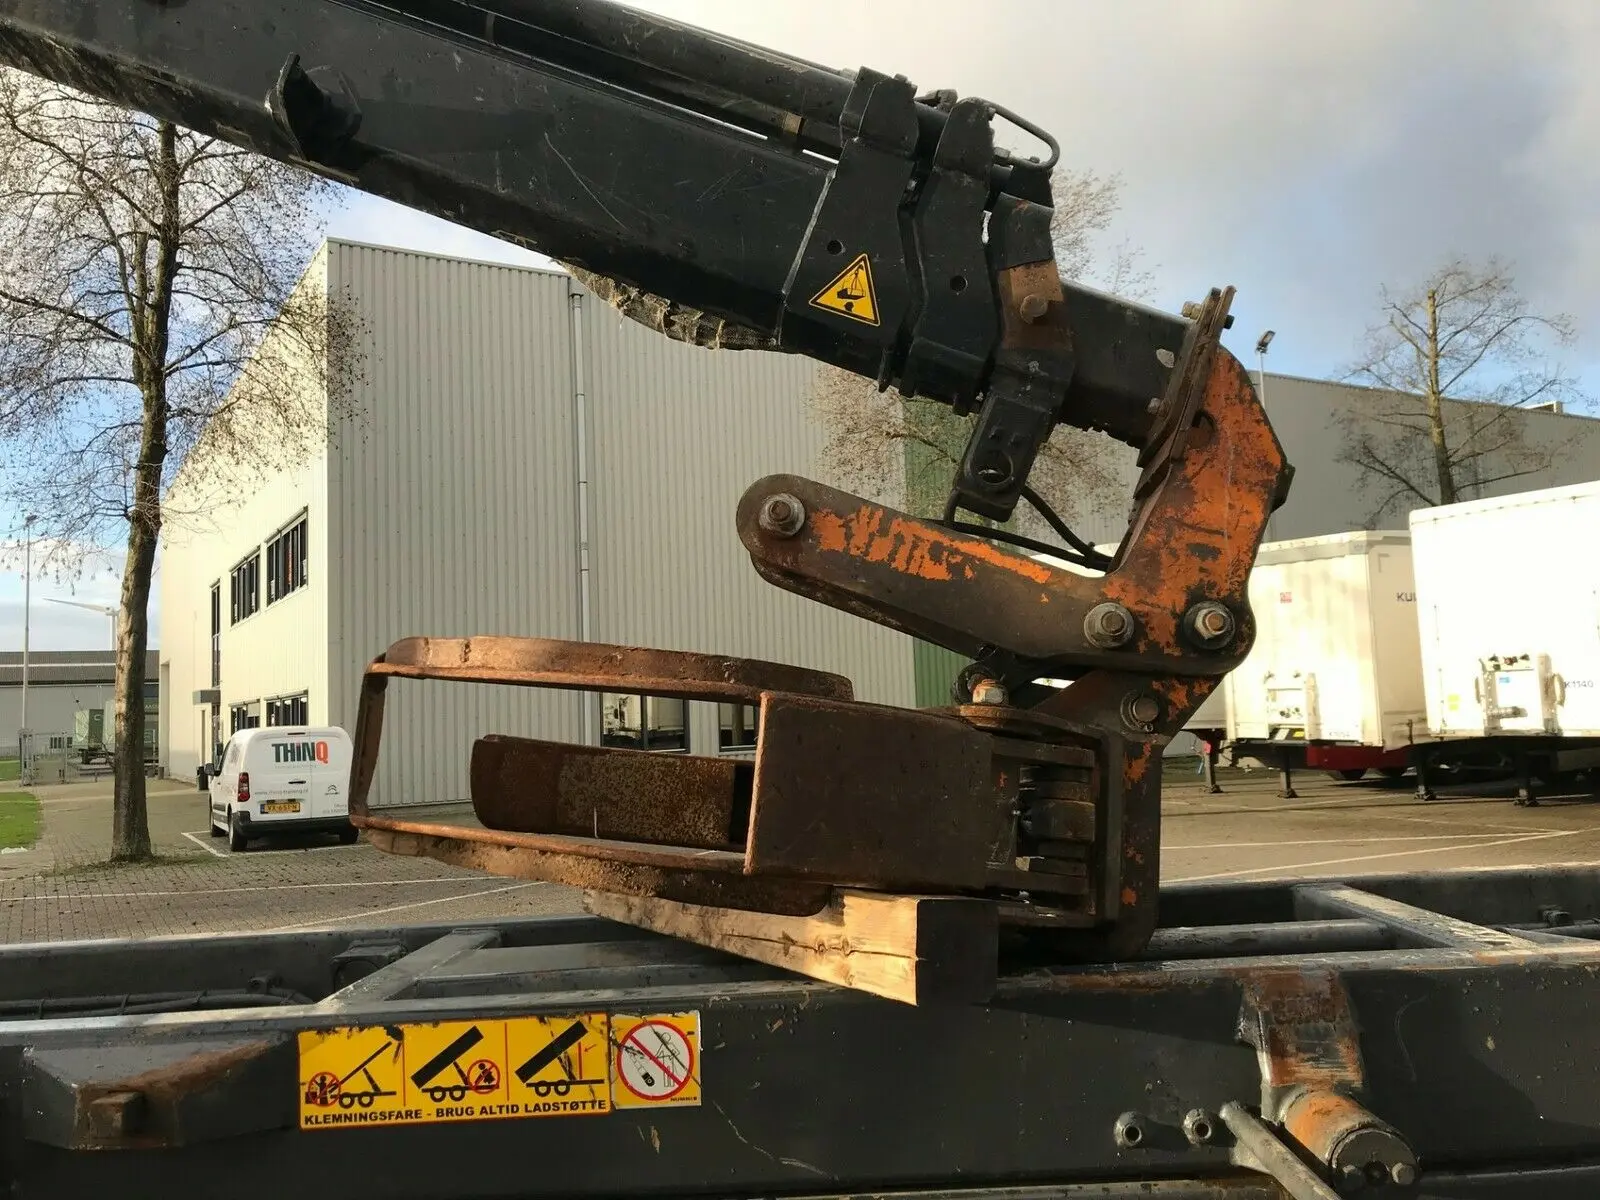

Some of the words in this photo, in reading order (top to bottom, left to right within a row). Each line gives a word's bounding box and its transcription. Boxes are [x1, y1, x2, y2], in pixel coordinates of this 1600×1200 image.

[304, 1109, 422, 1125] KLEMNINGSFARE
[436, 1106, 475, 1118] BRUG
[479, 1104, 520, 1115] ALTID
[525, 1100, 606, 1113] LADSTØTTE
